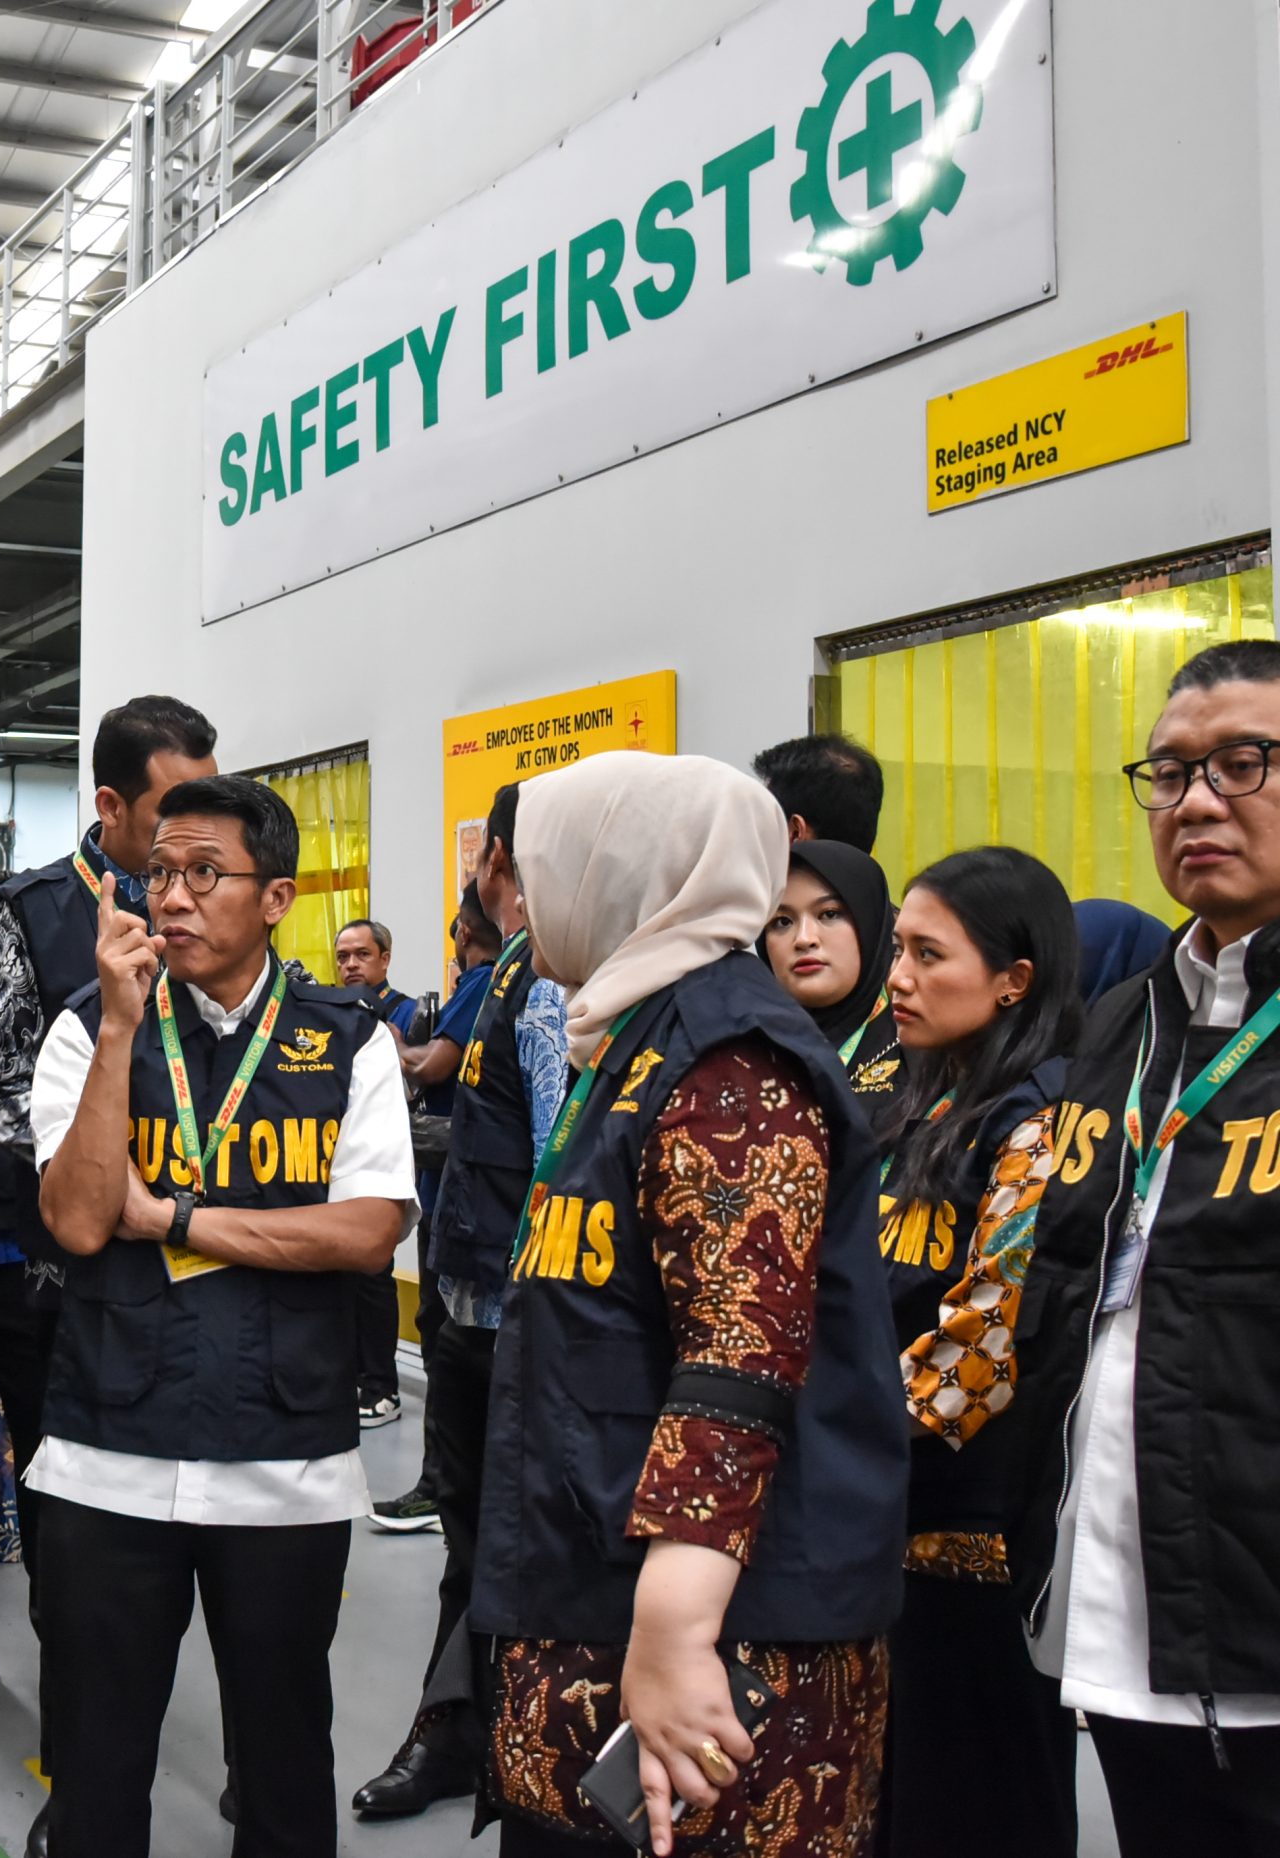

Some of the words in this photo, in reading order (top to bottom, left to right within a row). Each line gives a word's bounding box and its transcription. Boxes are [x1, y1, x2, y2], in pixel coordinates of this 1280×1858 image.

[218, 307, 456, 526] SAFETY
[485, 127, 775, 398] FIRST
[1090, 337, 1167, 378] DHL
[935, 425, 1018, 468] Released
[1025, 409, 1066, 441] NCY
[935, 463, 1006, 496] Staging
[1012, 446, 1058, 474] Area
[486, 723, 535, 750] EMPLOYEE
[537, 721, 551, 740] OF
[552, 715, 571, 735] THE
[574, 707, 613, 733] MONTH
[451, 740, 480, 757] DHL
[515, 752, 532, 770] JKT
[535, 747, 557, 767] GTW
[560, 741, 580, 762] OPS
[159, 984, 168, 1016] DHL
[262, 999, 279, 1035] DHL
[163, 1021, 178, 1055] VISITOR
[1207, 1031, 1259, 1084] VISITOR
[241, 1040, 264, 1077] VISITOR
[277, 1062, 335, 1073] CUSTOMS
[173, 1063, 188, 1102] DHL
[851, 1081, 894, 1093] USTOMS
[220, 1084, 244, 1127] DHL
[181, 1112, 196, 1152] VISITOR
[552, 1099, 581, 1152] VISITOR
